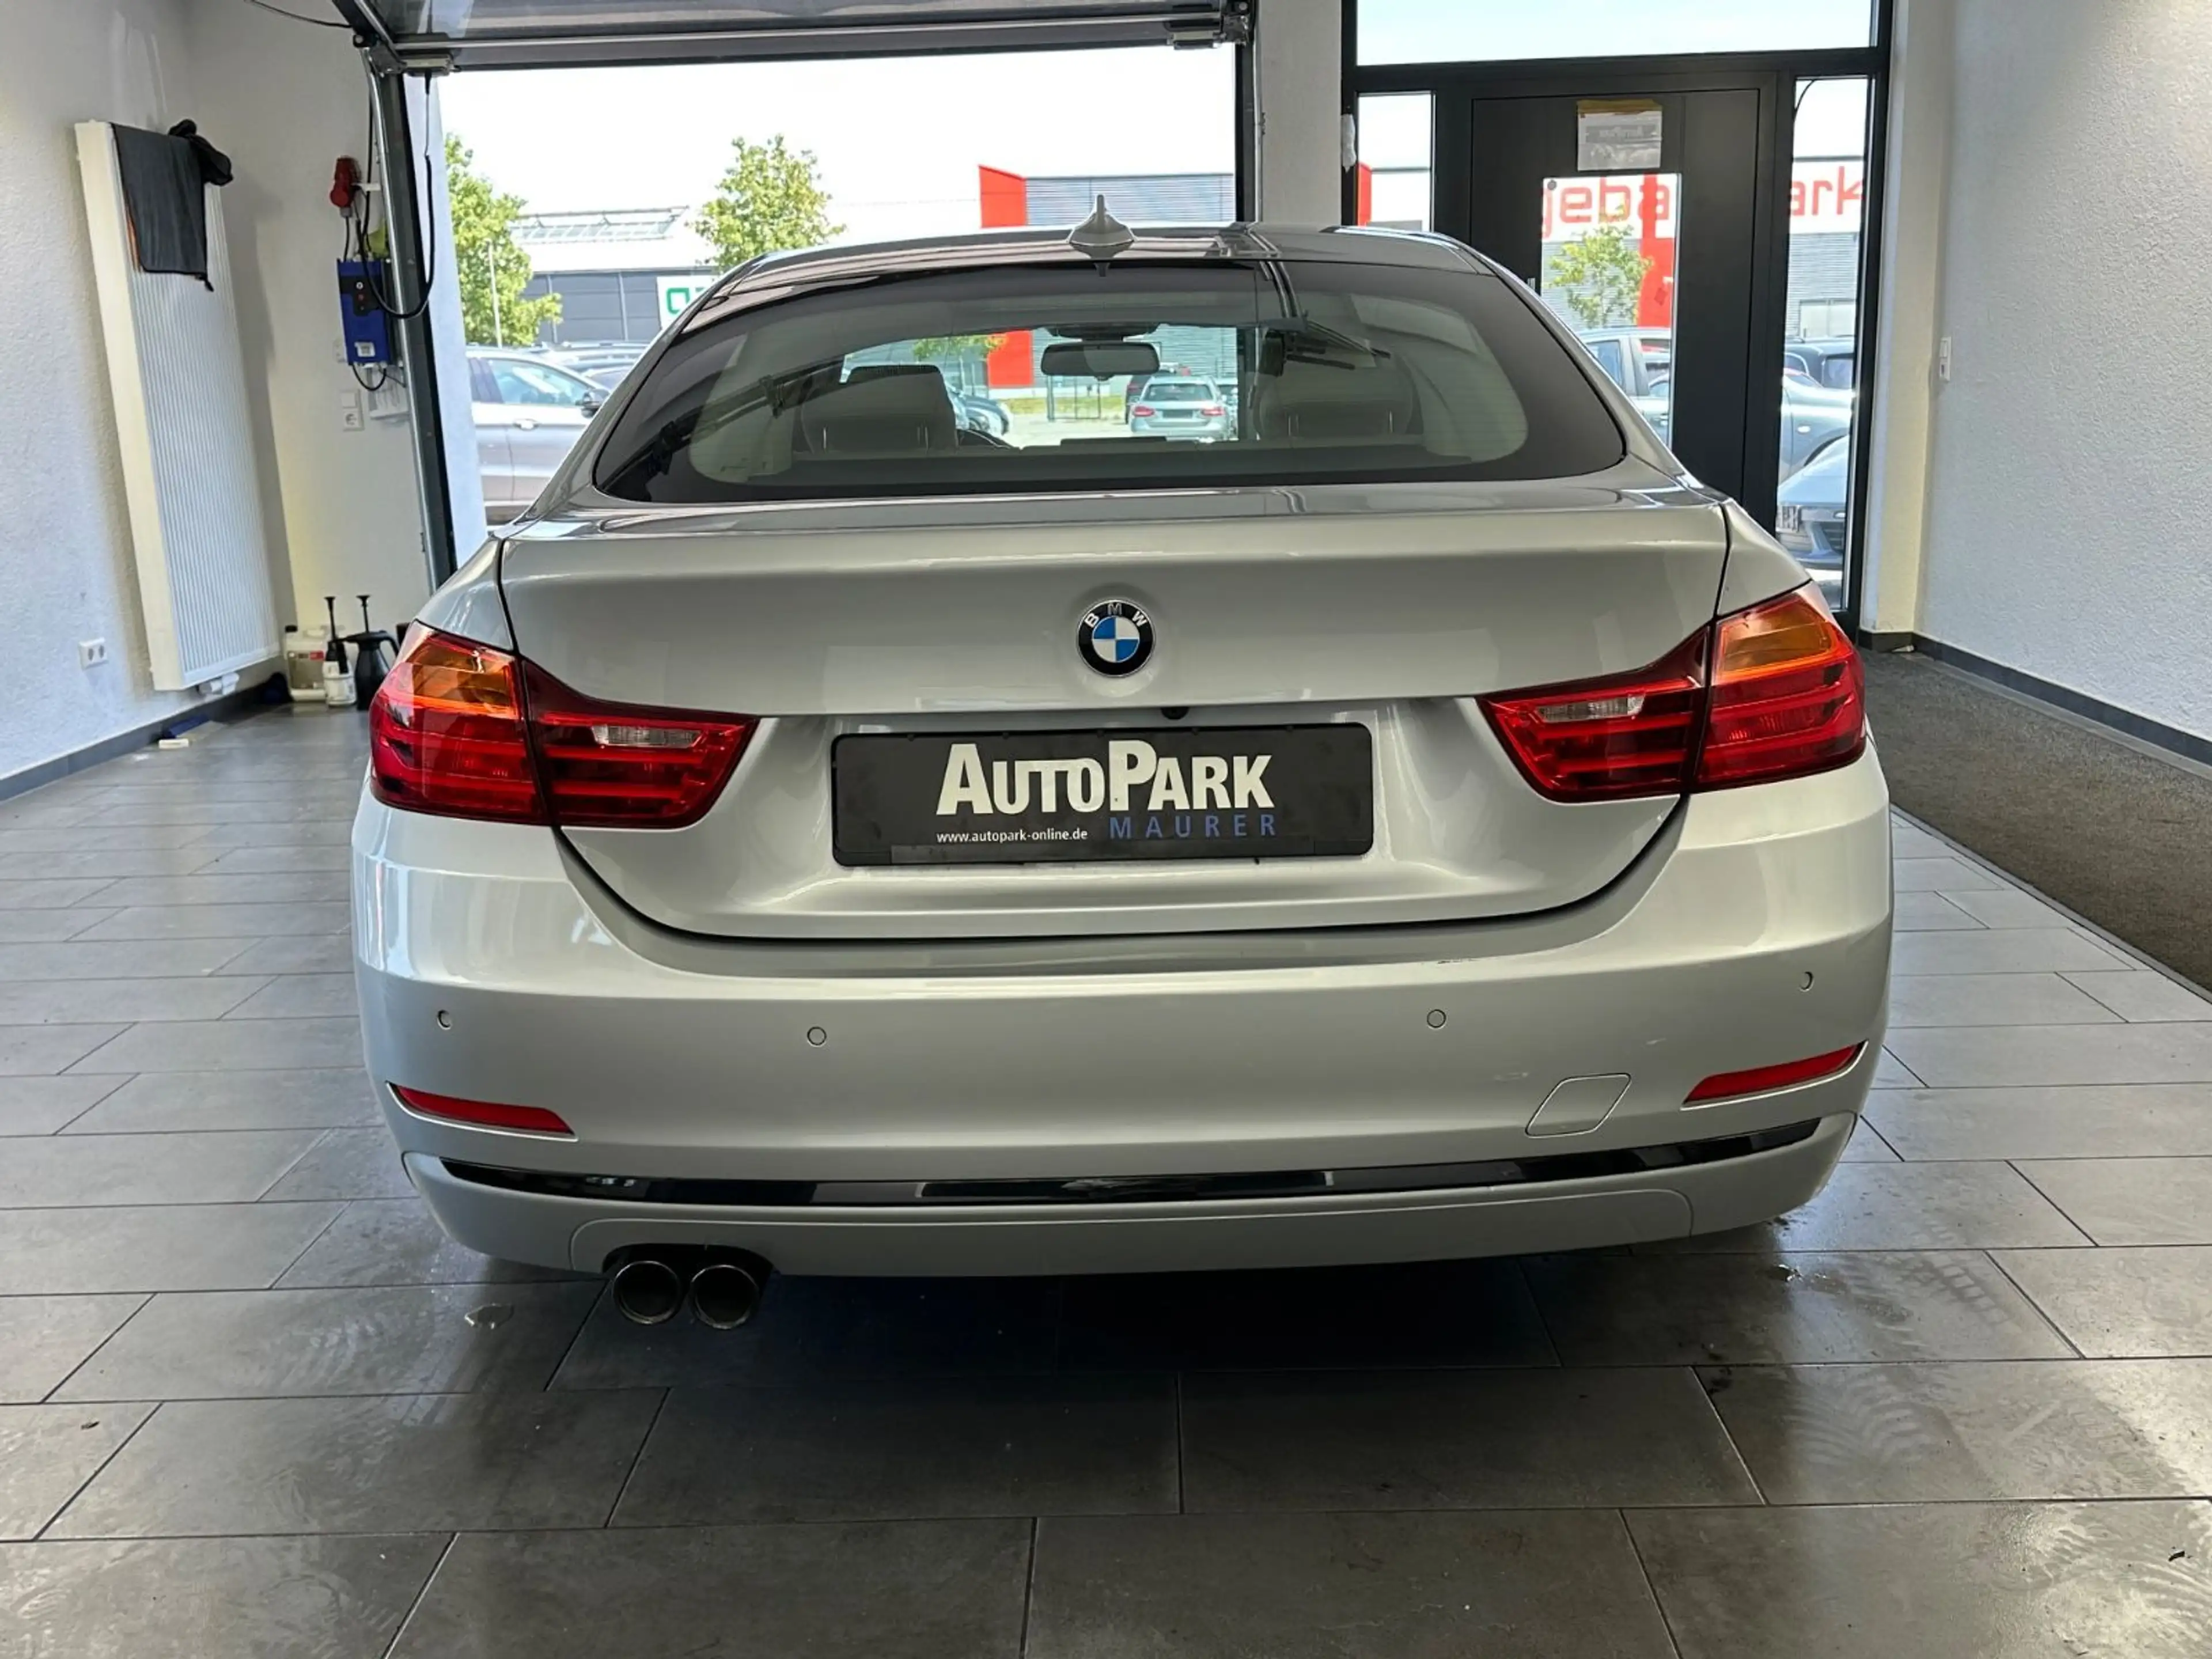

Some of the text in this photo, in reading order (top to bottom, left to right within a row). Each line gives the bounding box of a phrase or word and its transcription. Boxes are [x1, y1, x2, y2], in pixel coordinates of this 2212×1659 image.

[1084, 603, 1147, 628] BMW
[937, 828, 1088, 843] www.autopark-online.de
[1109, 814, 1275, 839] MAURER
